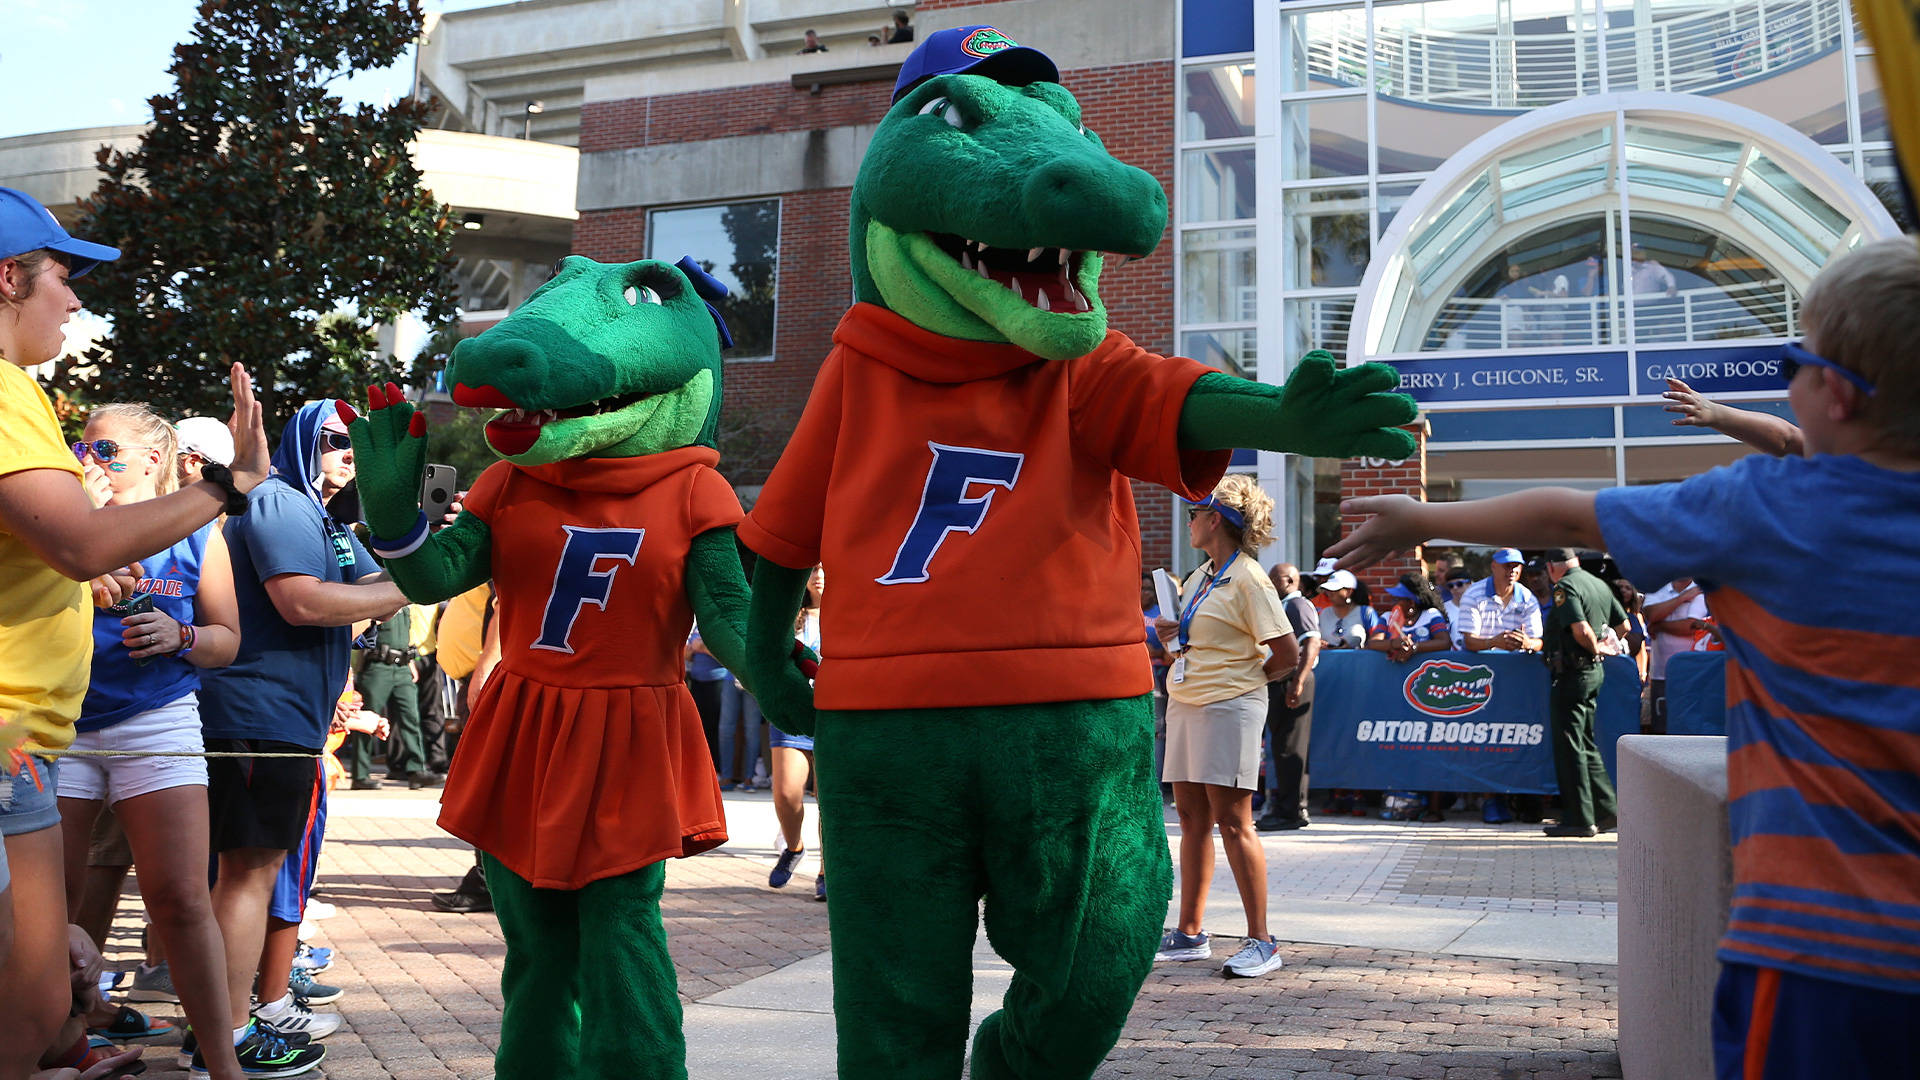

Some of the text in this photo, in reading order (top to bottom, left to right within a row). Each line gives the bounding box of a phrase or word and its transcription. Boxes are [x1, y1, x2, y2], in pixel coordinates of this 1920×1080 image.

[1391, 366, 1604, 391] ERRY J. CHICONE, SR.
[1646, 362, 1719, 380] GATOR
[874, 440, 1024, 586] F
[136, 578, 183, 597] MADE
[530, 525, 646, 655] F
[1356, 720, 1544, 745] GATOR BOOSTERS
